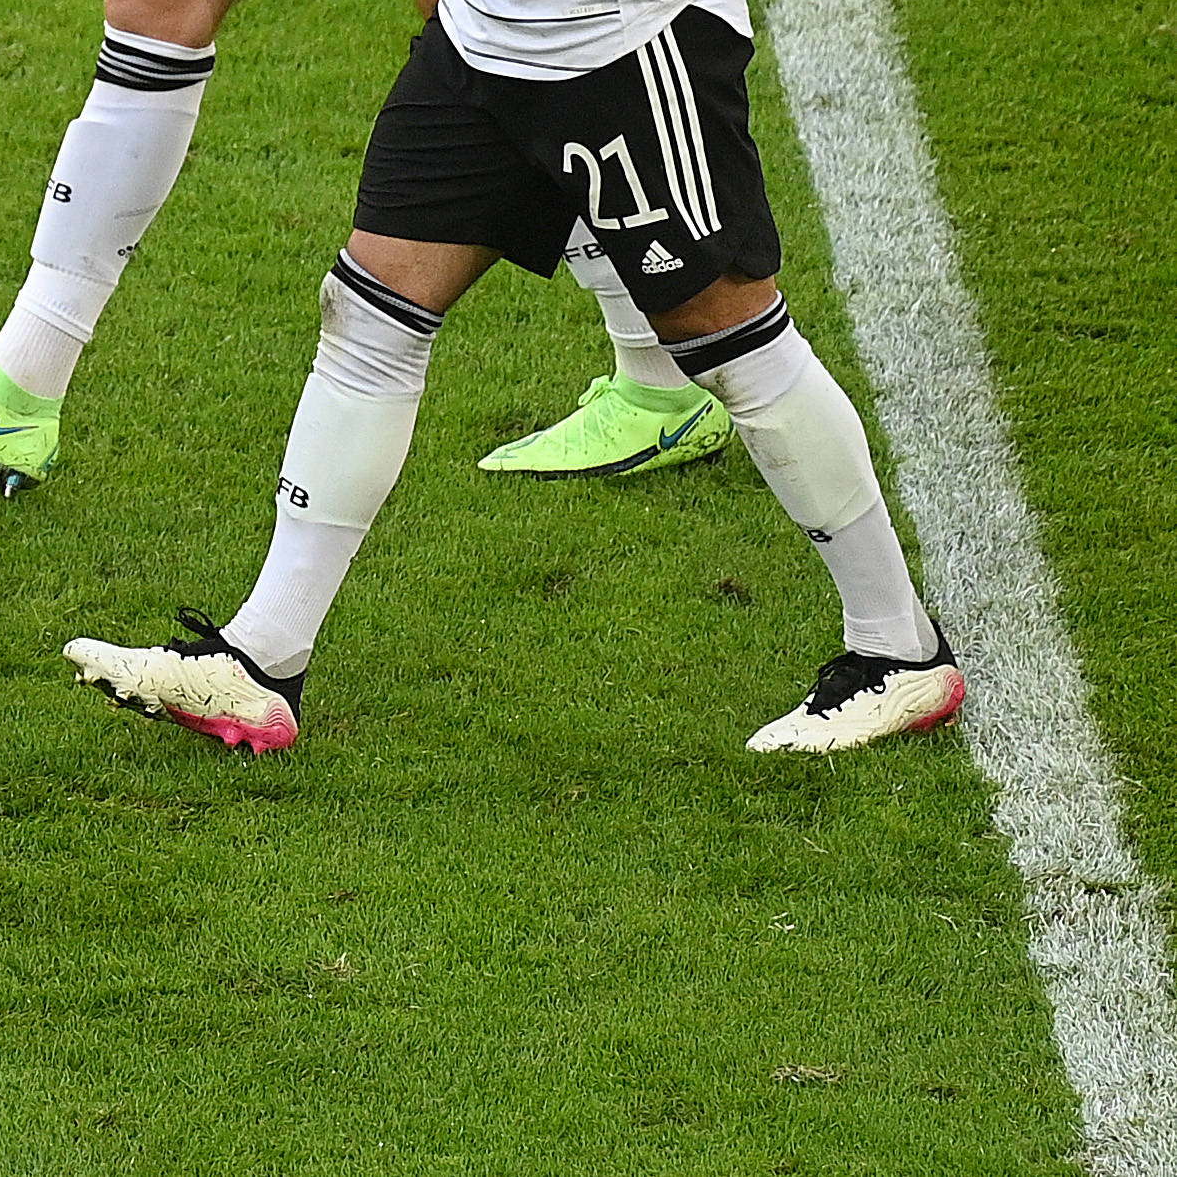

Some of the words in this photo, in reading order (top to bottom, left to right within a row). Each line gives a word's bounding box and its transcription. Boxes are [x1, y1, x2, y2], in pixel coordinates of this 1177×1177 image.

[563, 134, 669, 230] 21
[565, 243, 606, 264] FB
[641, 257, 684, 274] adidas
[277, 477, 309, 508] FB
